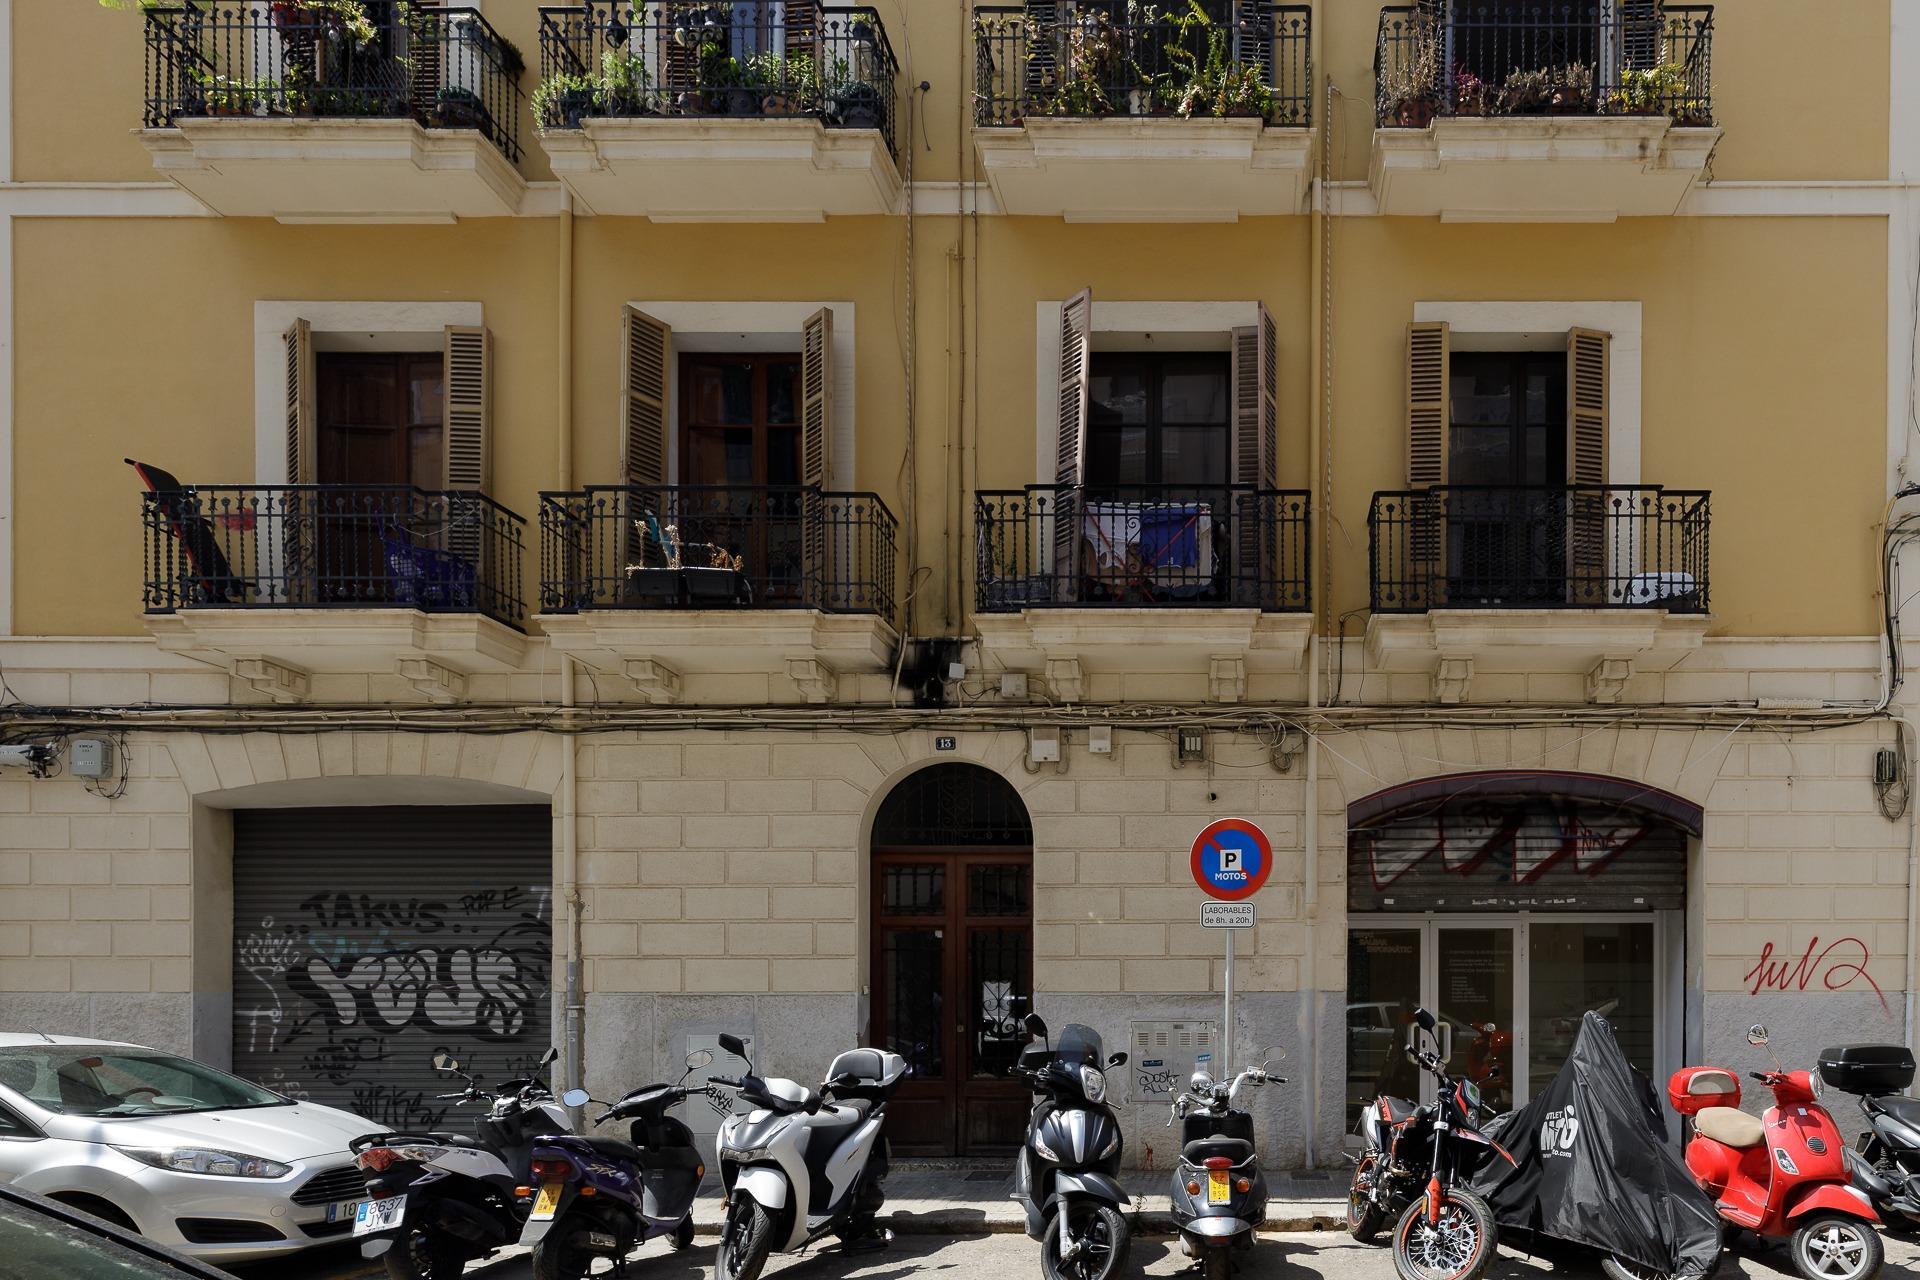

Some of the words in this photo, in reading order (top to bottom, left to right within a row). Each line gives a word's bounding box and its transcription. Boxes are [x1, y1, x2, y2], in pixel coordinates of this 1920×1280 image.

[940, 739, 952, 748] 13
[1224, 852, 1237, 868] P
[1214, 872, 1248, 880] MOTOS
[1204, 906, 1252, 914] LABORABLES
[1204, 916, 1214, 924] de
[1235, 916, 1252, 924] 20h.
[368, 1196, 404, 1214] 8637
[365, 1211, 392, 1228] JYW
